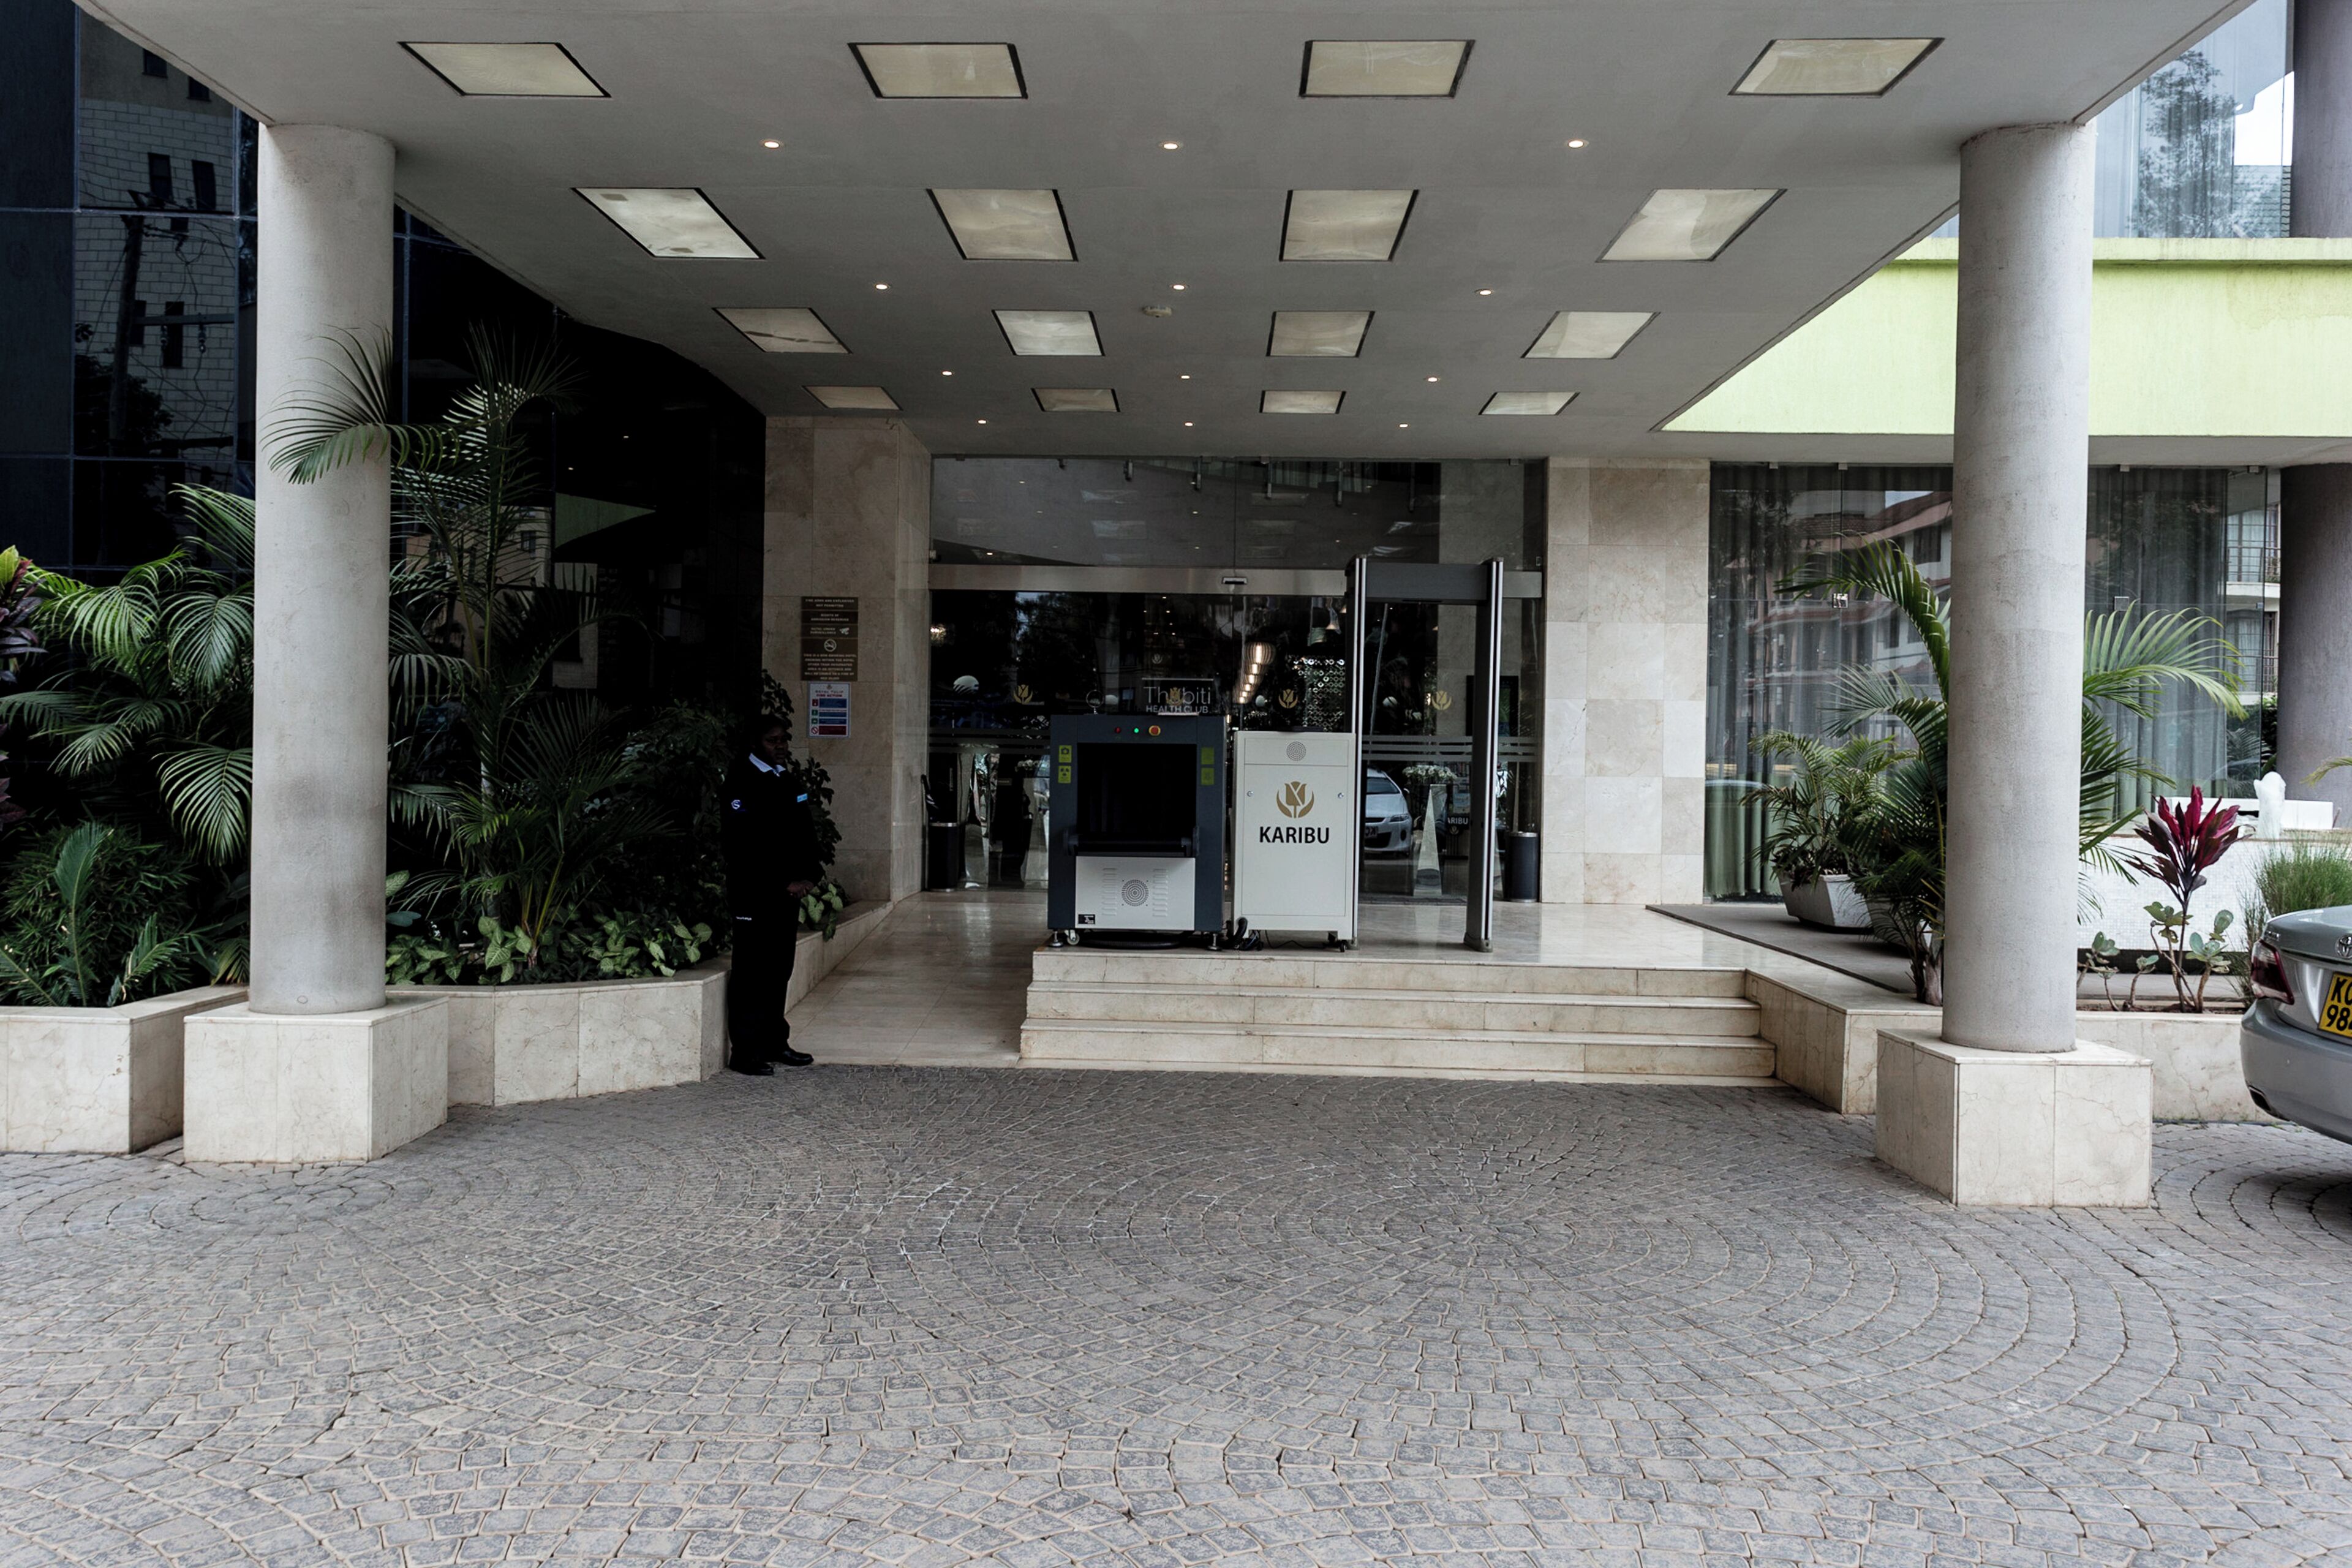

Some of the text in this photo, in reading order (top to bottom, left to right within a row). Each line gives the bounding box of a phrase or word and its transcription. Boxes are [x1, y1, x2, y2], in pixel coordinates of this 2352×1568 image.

[1143, 687, 1211, 704] Thbiti
[1146, 705, 1208, 714] HEALTH CLUB
[1260, 826, 1330, 844] KARIBU
[2327, 1005, 2352, 1031] 98
